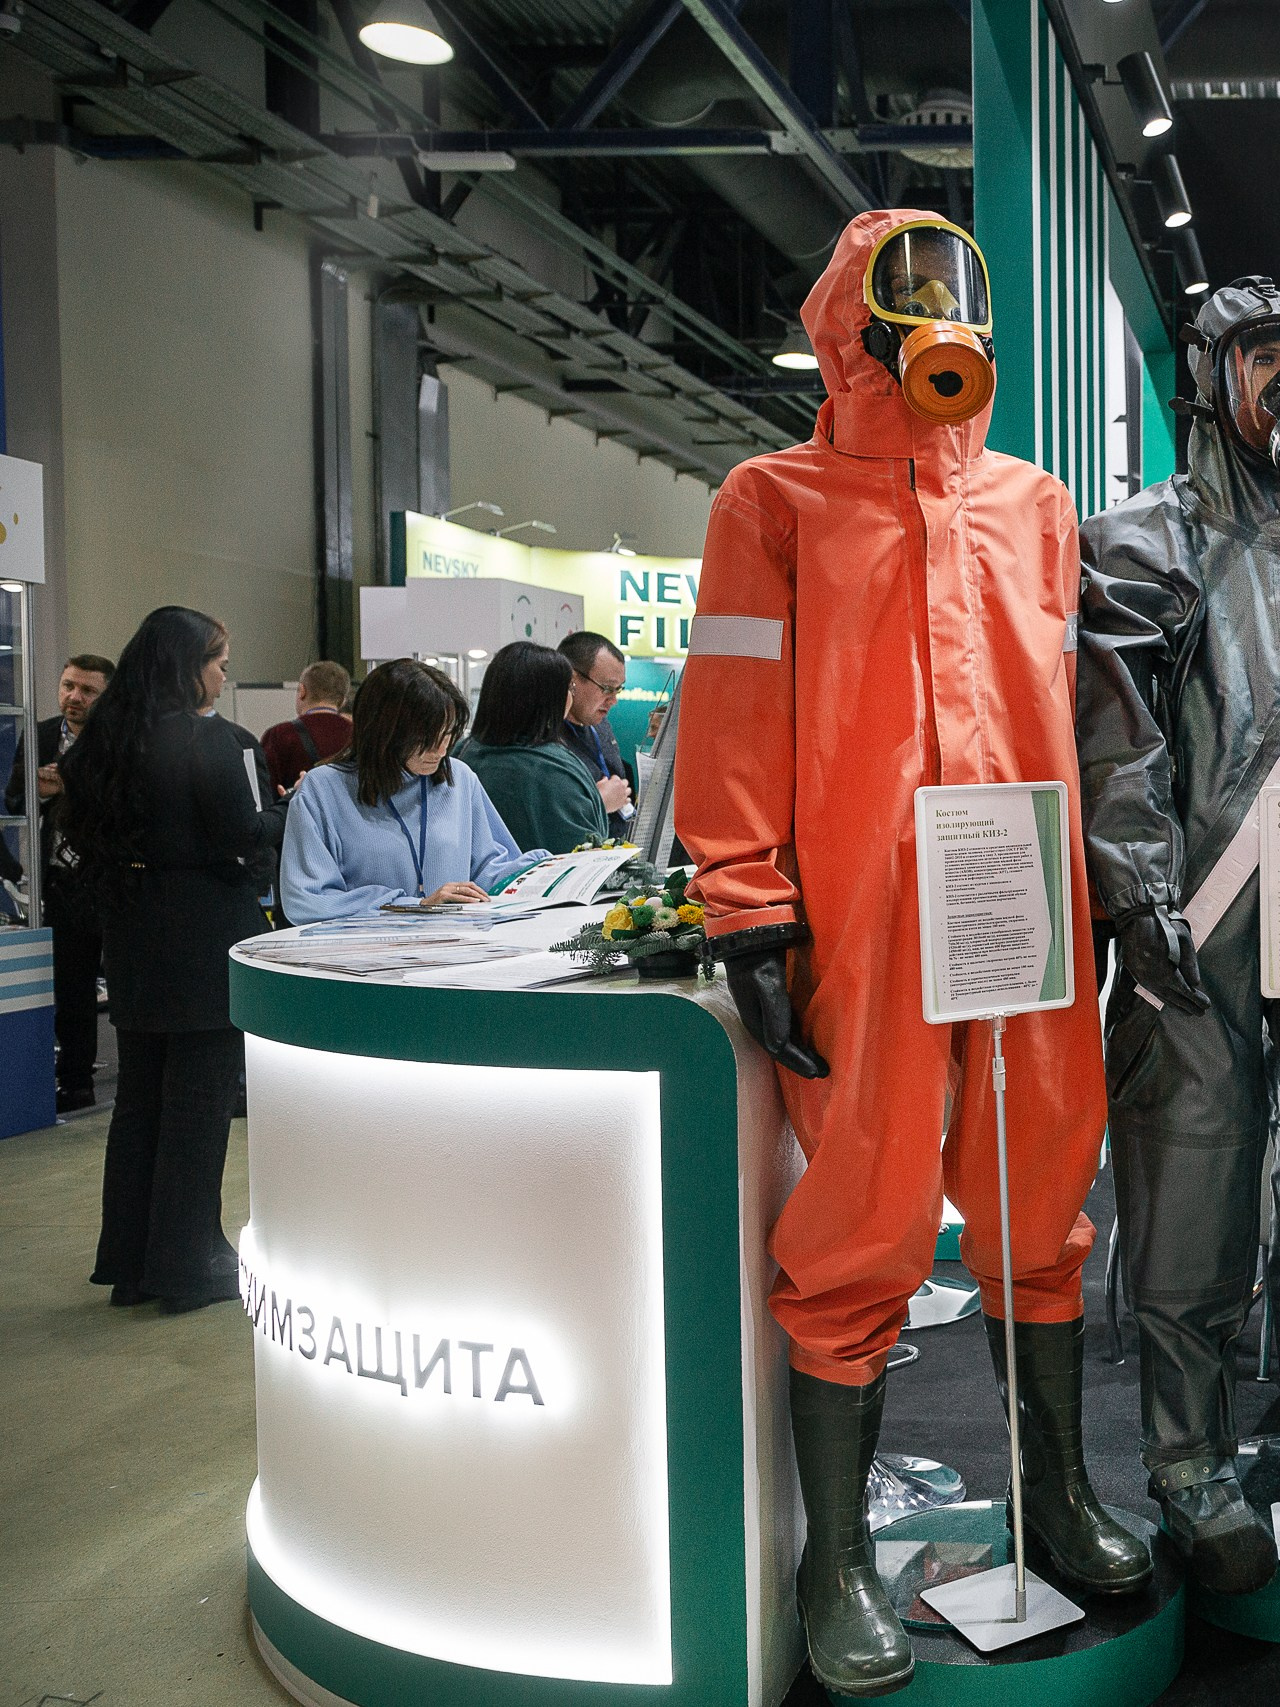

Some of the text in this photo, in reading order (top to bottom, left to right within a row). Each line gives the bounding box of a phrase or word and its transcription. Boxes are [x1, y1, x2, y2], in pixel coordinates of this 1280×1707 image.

[423, 550, 479, 578] NEVSKY
[935, 809, 969, 818] Костюм
[936, 818, 995, 830] изолирующий
[937, 828, 1008, 842] защитный КИЗ-2
